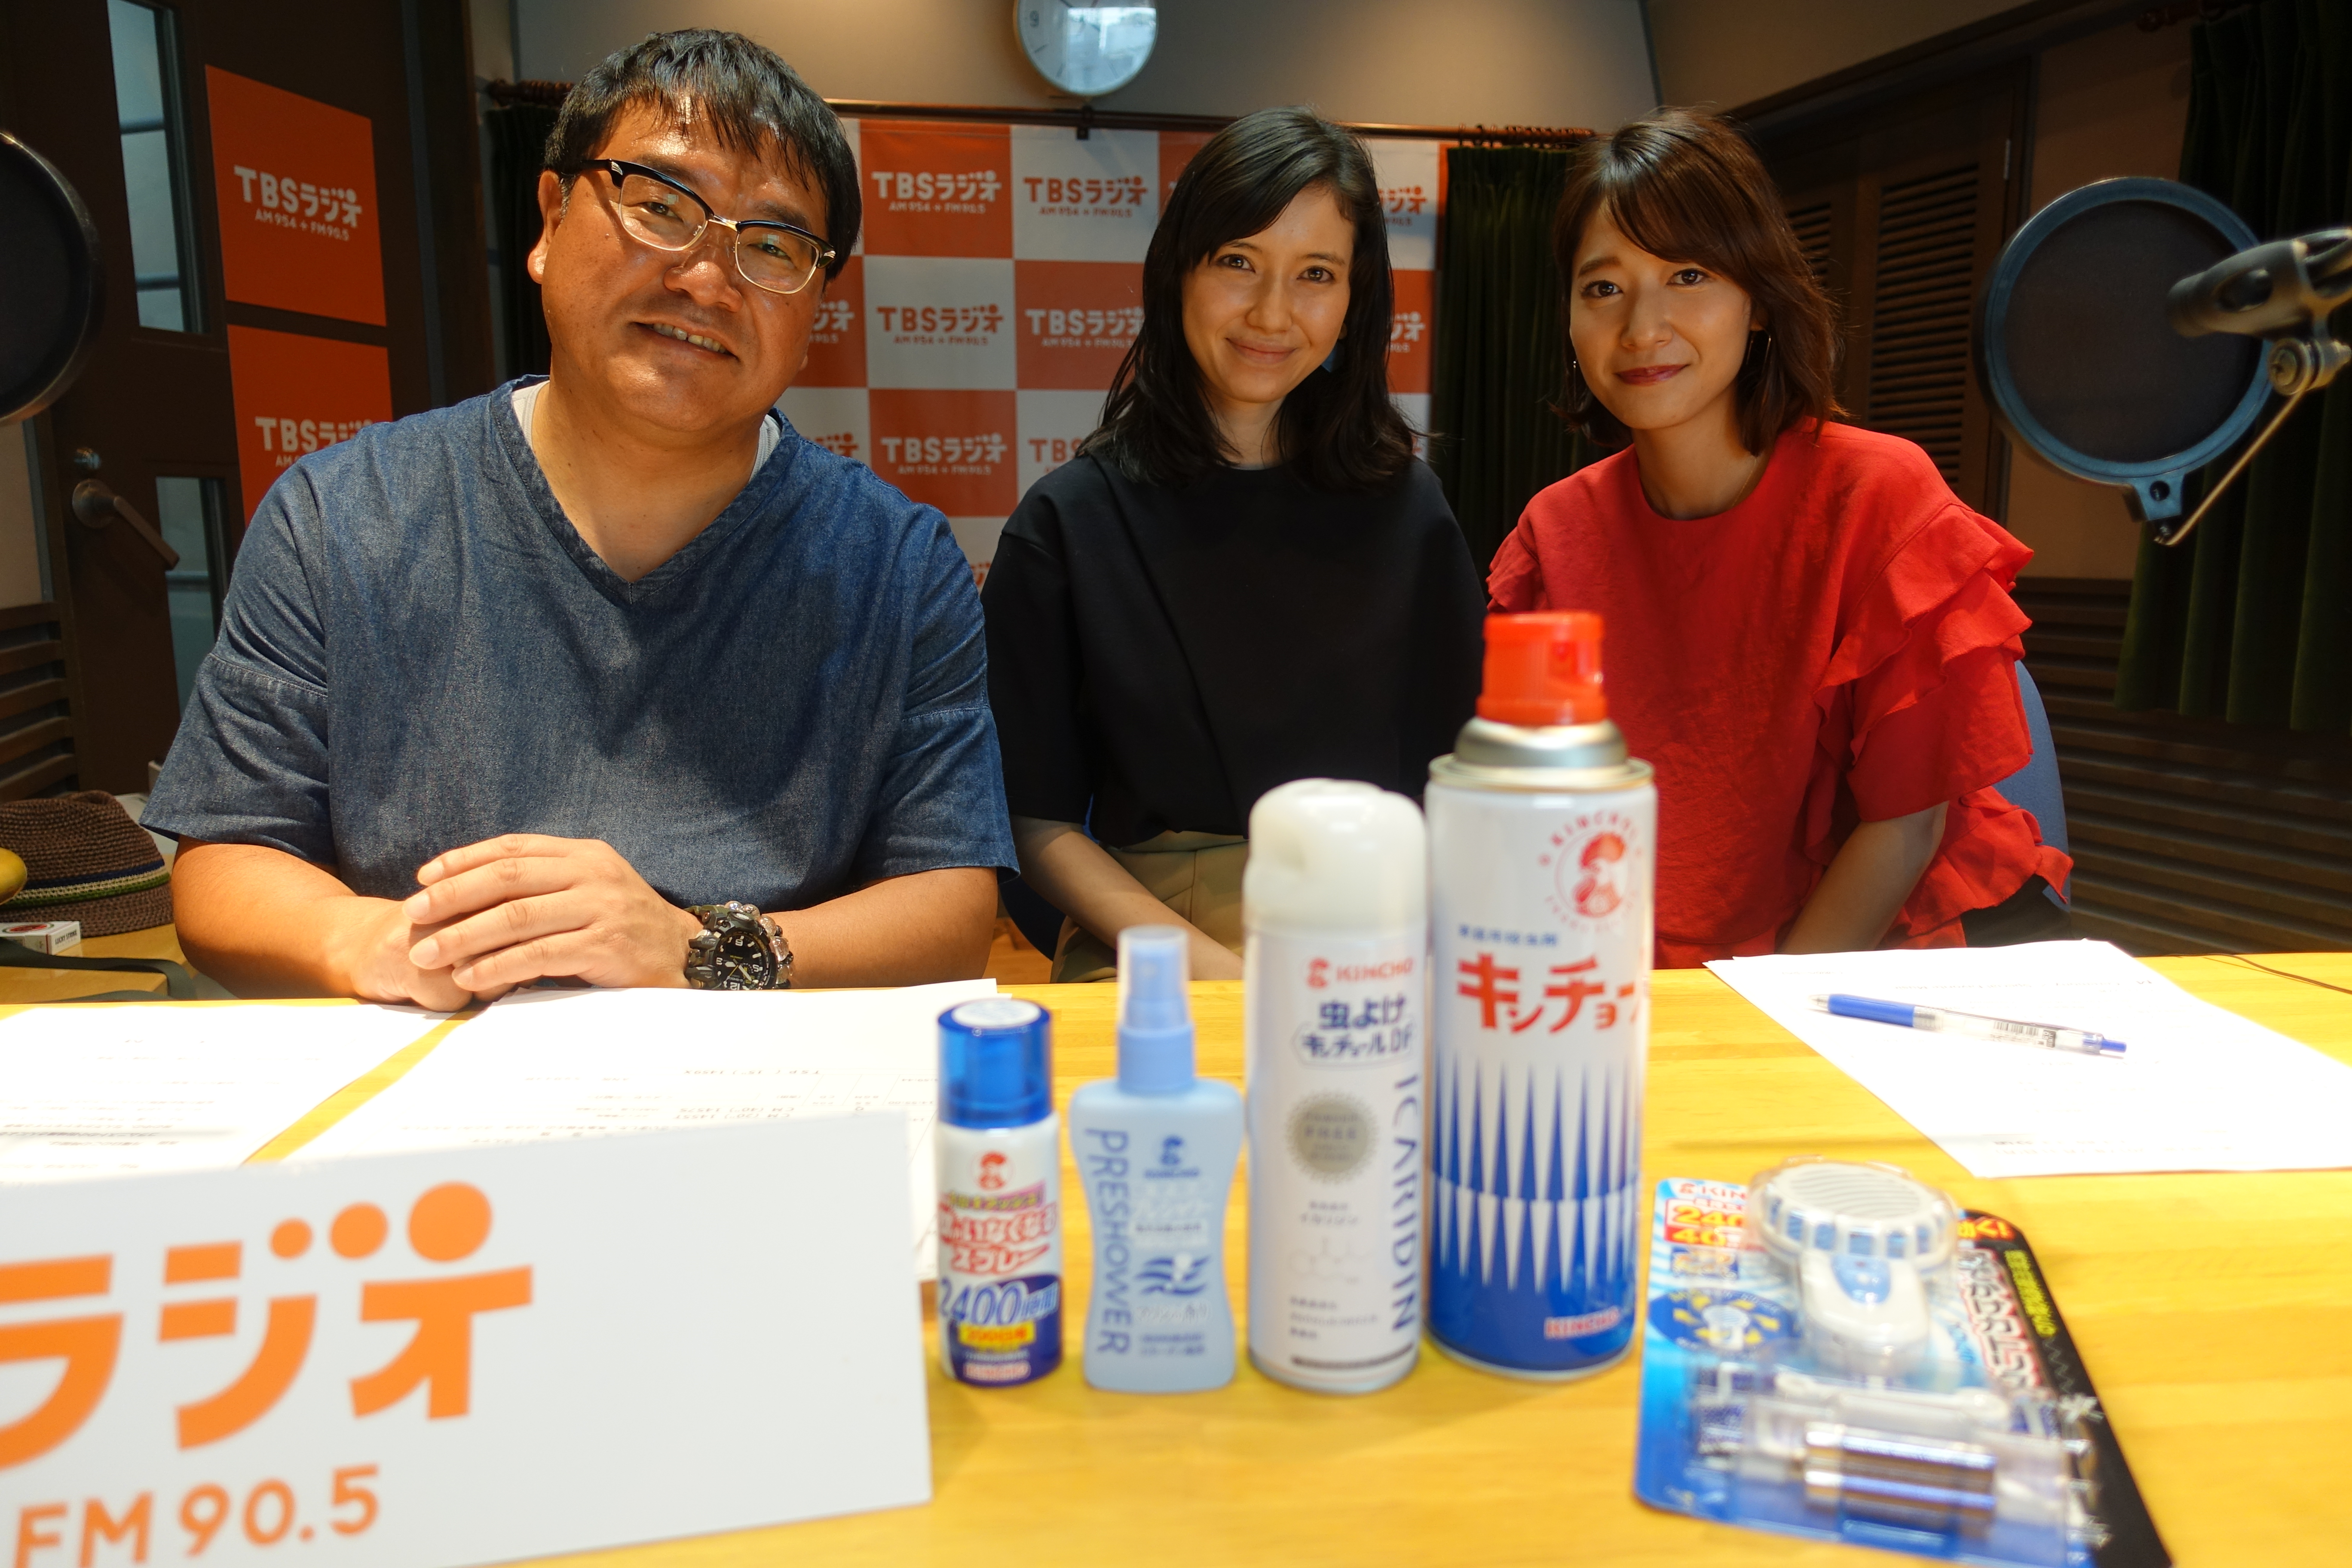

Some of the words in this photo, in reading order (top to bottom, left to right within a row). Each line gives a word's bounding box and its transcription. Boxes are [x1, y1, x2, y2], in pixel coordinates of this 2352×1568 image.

[233, 165, 362, 228] TBSラジオ
[870, 169, 1002, 202] TBSラジオ
[1022, 176, 1148, 207] TBSラジオ
[876, 303, 1004, 334] TBSラジオ
[880, 432, 1007, 464] TBSラジオ
[1319, 992, 1406, 1030] 虫よけ
[1702, 1186, 1748, 1200] KIN
[1084, 1128, 1133, 1354] PRESHOWER
[1672, 1228, 1727, 1246] 40
